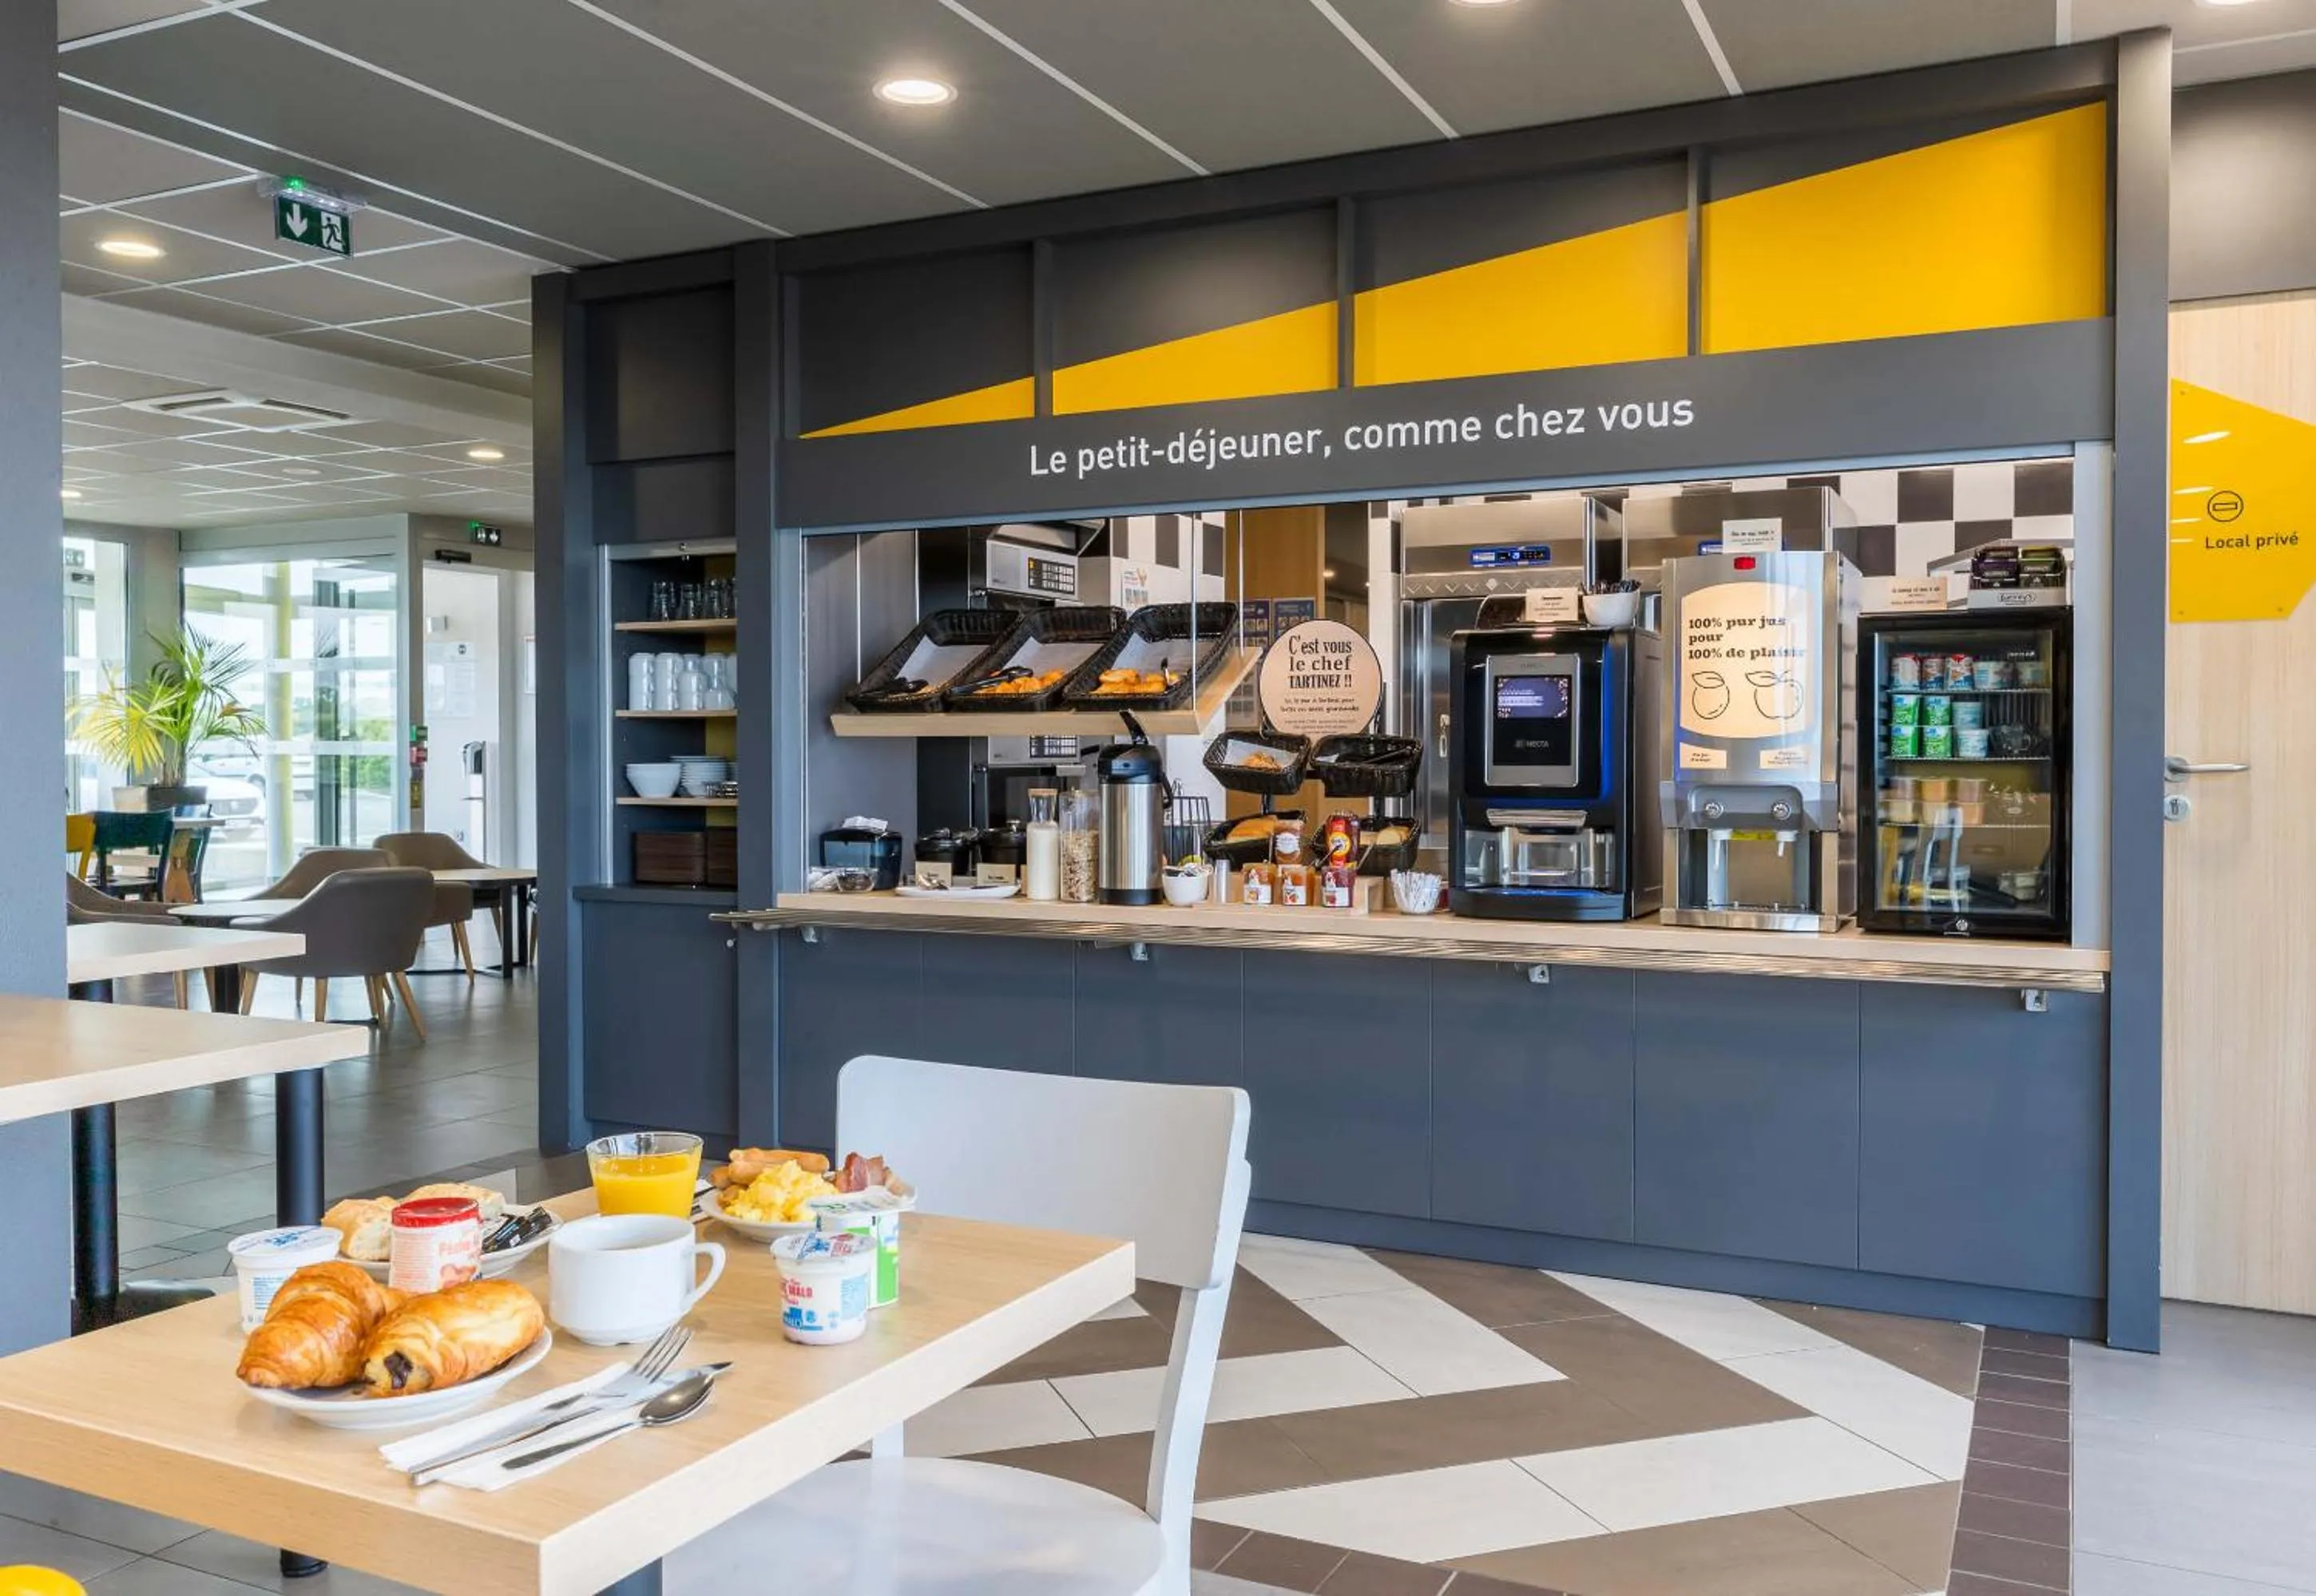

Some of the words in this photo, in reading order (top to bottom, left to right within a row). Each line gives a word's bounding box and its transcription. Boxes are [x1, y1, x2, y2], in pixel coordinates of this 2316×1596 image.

[1031, 445, 1067, 476] Le
[1078, 427, 1332, 479] petit-déjeuner,
[1344, 415, 1482, 450] comme
[1495, 403, 1585, 439] chez
[1597, 398, 1694, 432] vous
[2205, 534, 2251, 549] Local
[2256, 531, 2299, 550] privé
[1688, 616, 1723, 629] 100%
[1726, 617, 1756, 631] pur
[1759, 616, 1787, 629] jus
[1288, 635, 1319, 655] C'est
[1323, 640, 1352, 654] vous
[1688, 632, 1724, 646] pour
[1688, 648, 1723, 660] 100%
[1726, 647, 1746, 659] de
[1750, 647, 1806, 660] plaisir
[1289, 655, 1306, 672] le
[1311, 655, 1353, 671] chef
[1287, 674, 1341, 690] TARTINEZ
